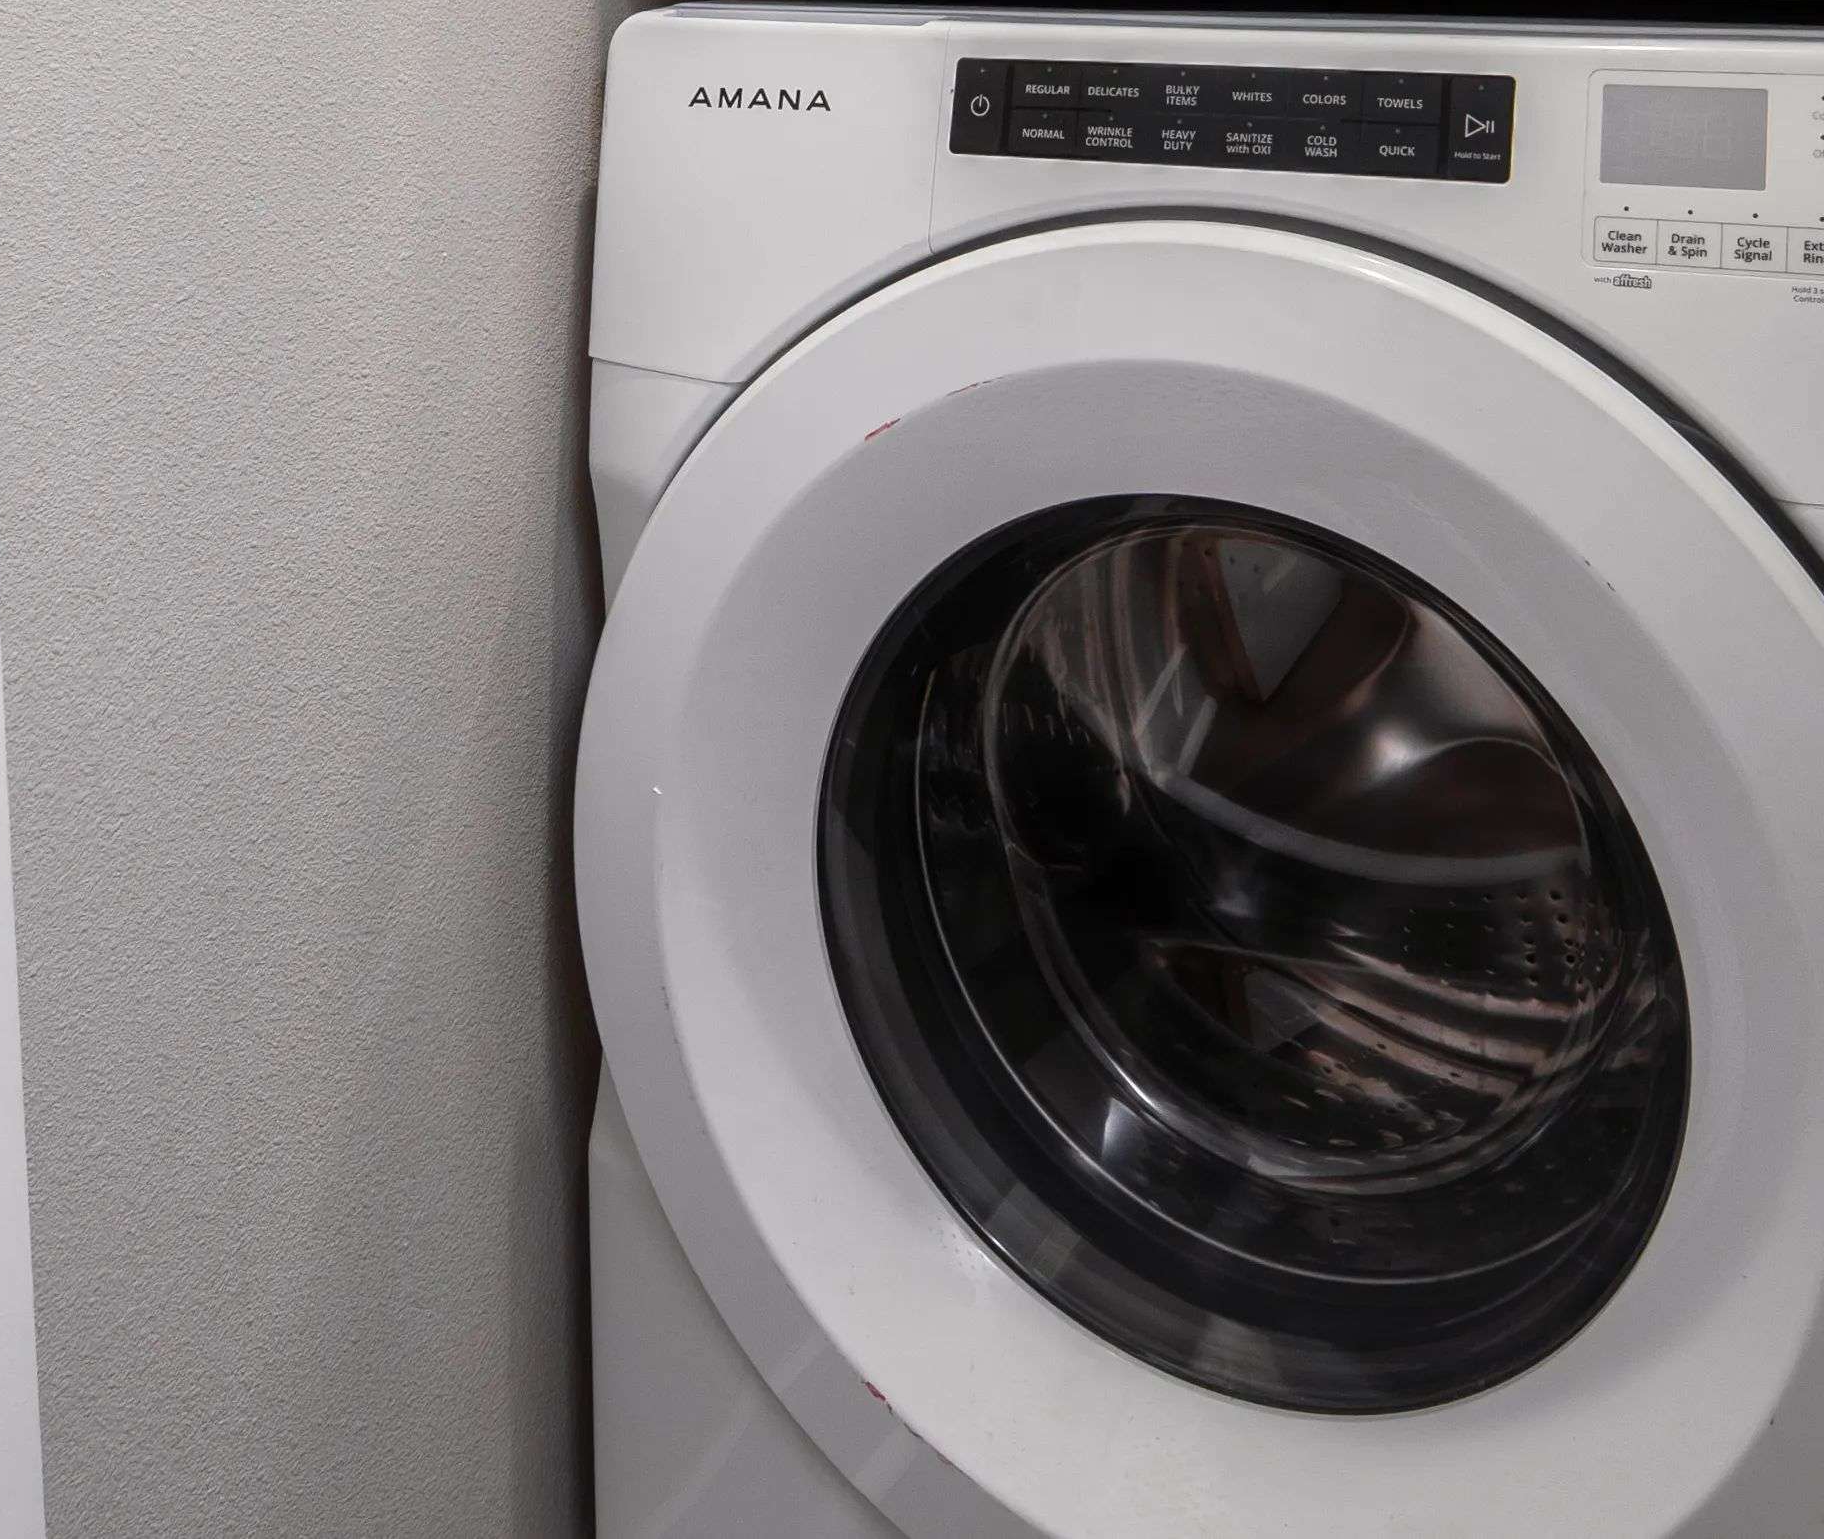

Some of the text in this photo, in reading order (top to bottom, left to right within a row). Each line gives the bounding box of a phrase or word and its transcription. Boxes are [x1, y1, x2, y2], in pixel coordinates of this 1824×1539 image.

[1025, 84, 1070, 95] REGULAR
[1087, 86, 1140, 98] DELICATES
[1165, 85, 1200, 96] BULKY
[688, 87, 831, 111] AMANA
[1166, 96, 1198, 106] ITEMS
[1232, 91, 1272, 102] WHITES
[1302, 94, 1347, 106] COLORS
[1377, 97, 1423, 109] TOWELS
[1022, 128, 1065, 140] NORMAL
[1087, 126, 1133, 138] WRINKLE
[1161, 129, 1196, 141] HEAVY
[1226, 132, 1273, 144] SANITIZE
[1085, 137, 1133, 149] CONTROL
[1163, 141, 1193, 151] DUTY
[1307, 135, 1337, 146] COLD
[1226, 144, 1272, 155] with OXI
[1305, 147, 1338, 158] WASH
[1379, 145, 1415, 157] QUICK
[1482, 152, 1501, 160] Start
[1607, 230, 1642, 241] Clean
[1671, 233, 1705, 245] Drain
[1601, 242, 1648, 255] Washer
[1737, 237, 1770, 249] Cycle
[1667, 246, 1708, 259] & Spin
[1734, 249, 1772, 263] Signal
[1792, 286, 1811, 294] Hold
[1793, 295, 1824, 304] Control
